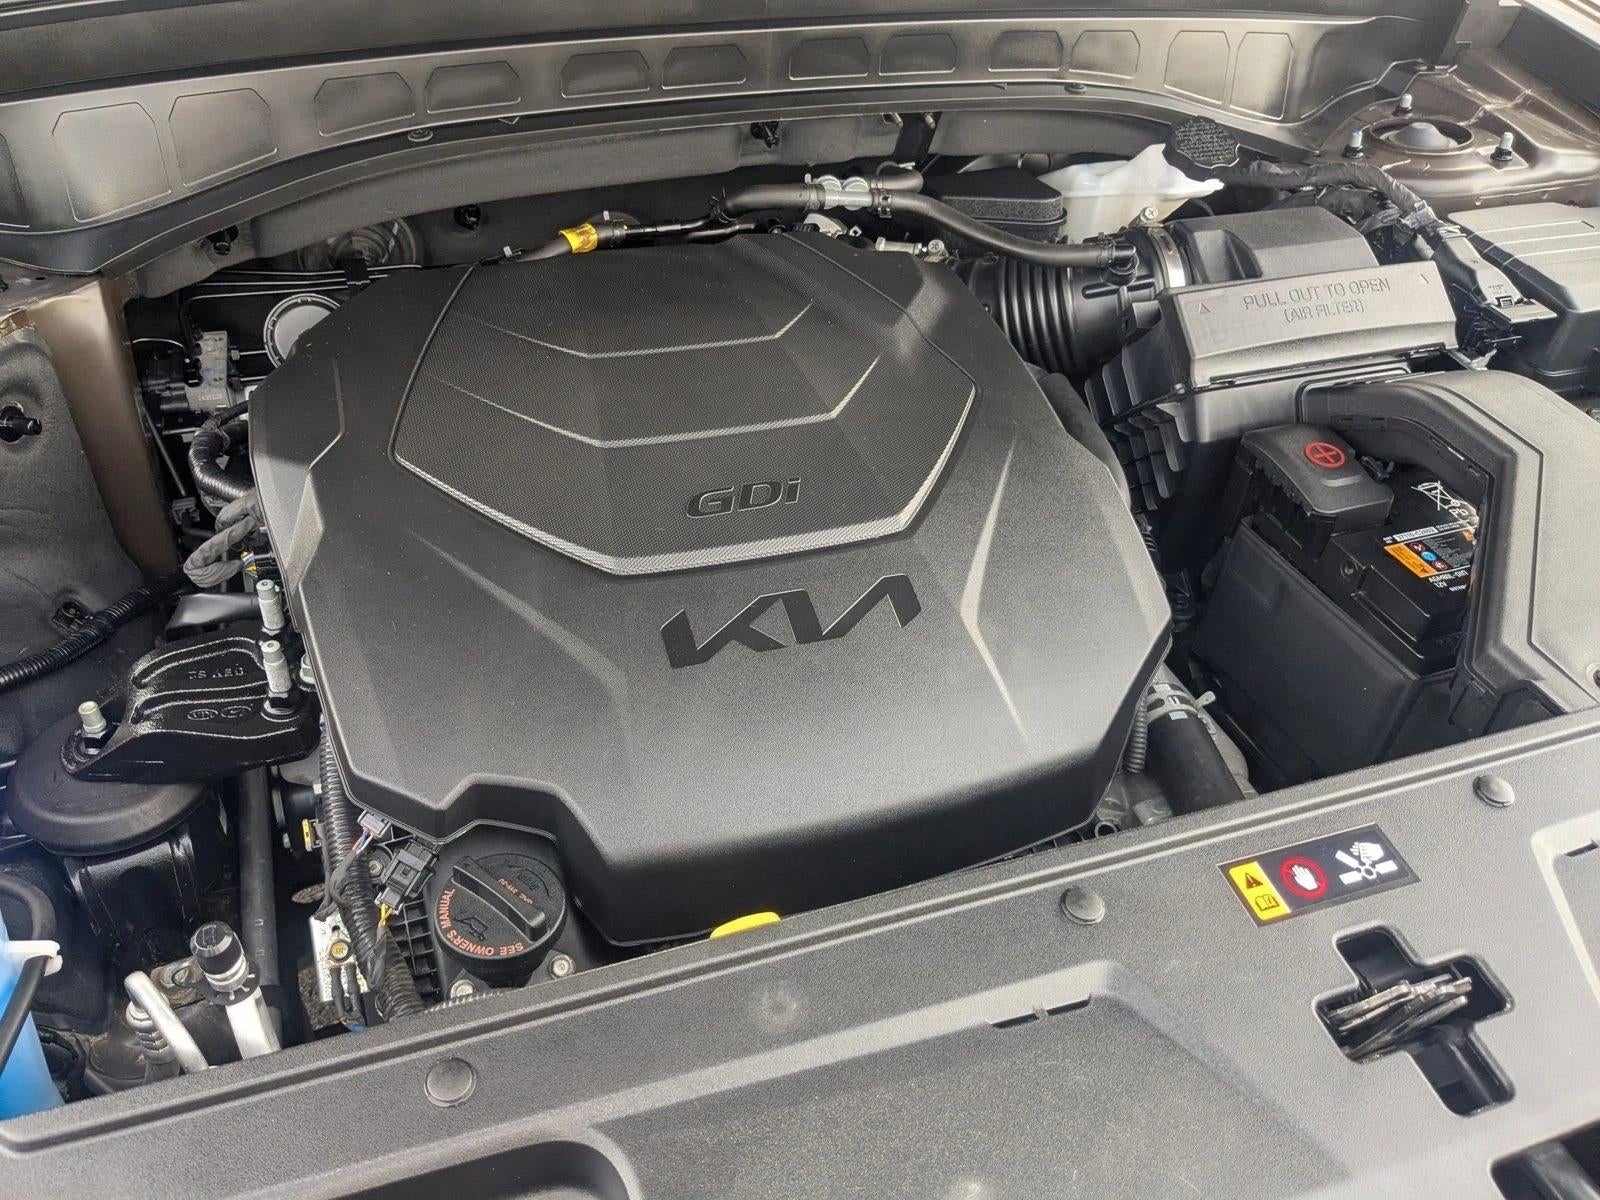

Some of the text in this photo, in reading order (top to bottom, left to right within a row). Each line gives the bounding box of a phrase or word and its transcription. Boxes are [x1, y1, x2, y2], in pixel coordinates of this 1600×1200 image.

[1243, 277, 1392, 310] PULL OUT TO OPEN
[1283, 299, 1366, 323] (AIR FILTER)
[685, 477, 801, 519] GDi
[1448, 507, 1469, 518] Pb
[1434, 580, 1448, 589] 12V
[439, 888, 524, 956] SEE OWNER'S MANUAL
